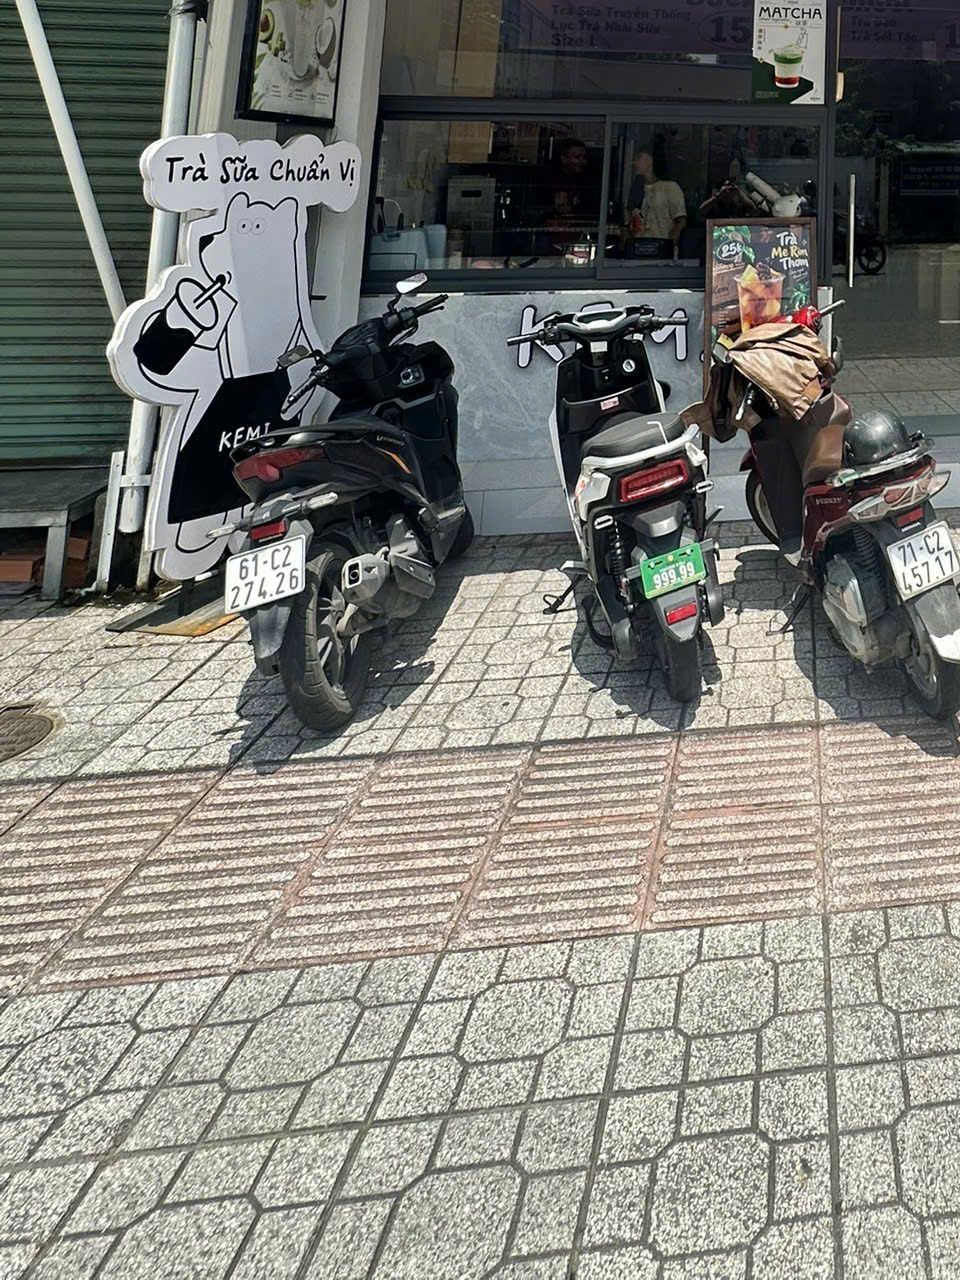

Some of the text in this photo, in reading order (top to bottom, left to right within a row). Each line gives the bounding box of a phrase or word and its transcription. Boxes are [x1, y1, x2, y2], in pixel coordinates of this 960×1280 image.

[758, 6, 823, 20] MATCHA
[166, 152, 356, 187] Trà Sữa Chuẩn Vị
[776, 231, 798, 247] Trà
[218, 422, 271, 452] KEMI
[239, 545, 292, 581] 61-C2
[898, 530, 944, 565] 71-C2
[230, 568, 299, 610] 274.26
[903, 550, 955, 594] 457.17
